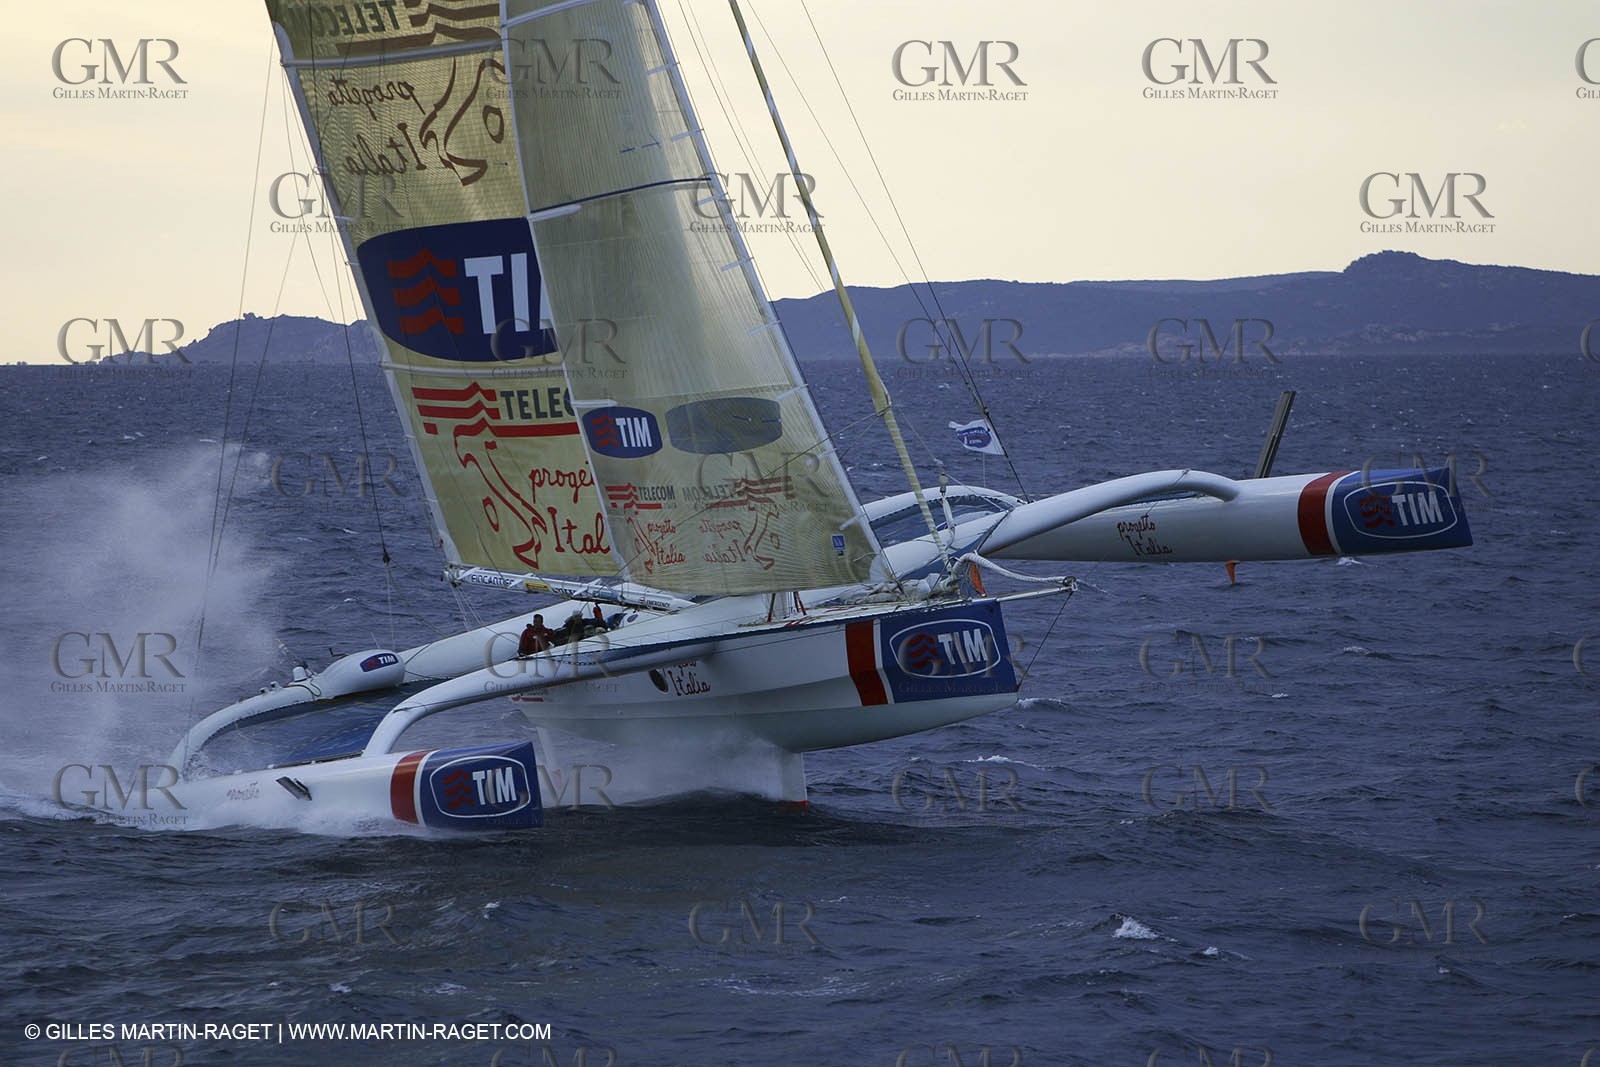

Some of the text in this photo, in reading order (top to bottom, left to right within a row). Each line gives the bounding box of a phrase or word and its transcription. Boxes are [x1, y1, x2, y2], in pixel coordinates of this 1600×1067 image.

[615, 416, 653, 448] TIM
[528, 460, 595, 504] proge
[639, 485, 676, 501] TELECOM
[1392, 490, 1444, 527] TIM
[654, 540, 686, 565] Italia
[378, 655, 396, 665] TIM
[938, 628, 989, 665] TIM
[472, 766, 517, 806] TIM
